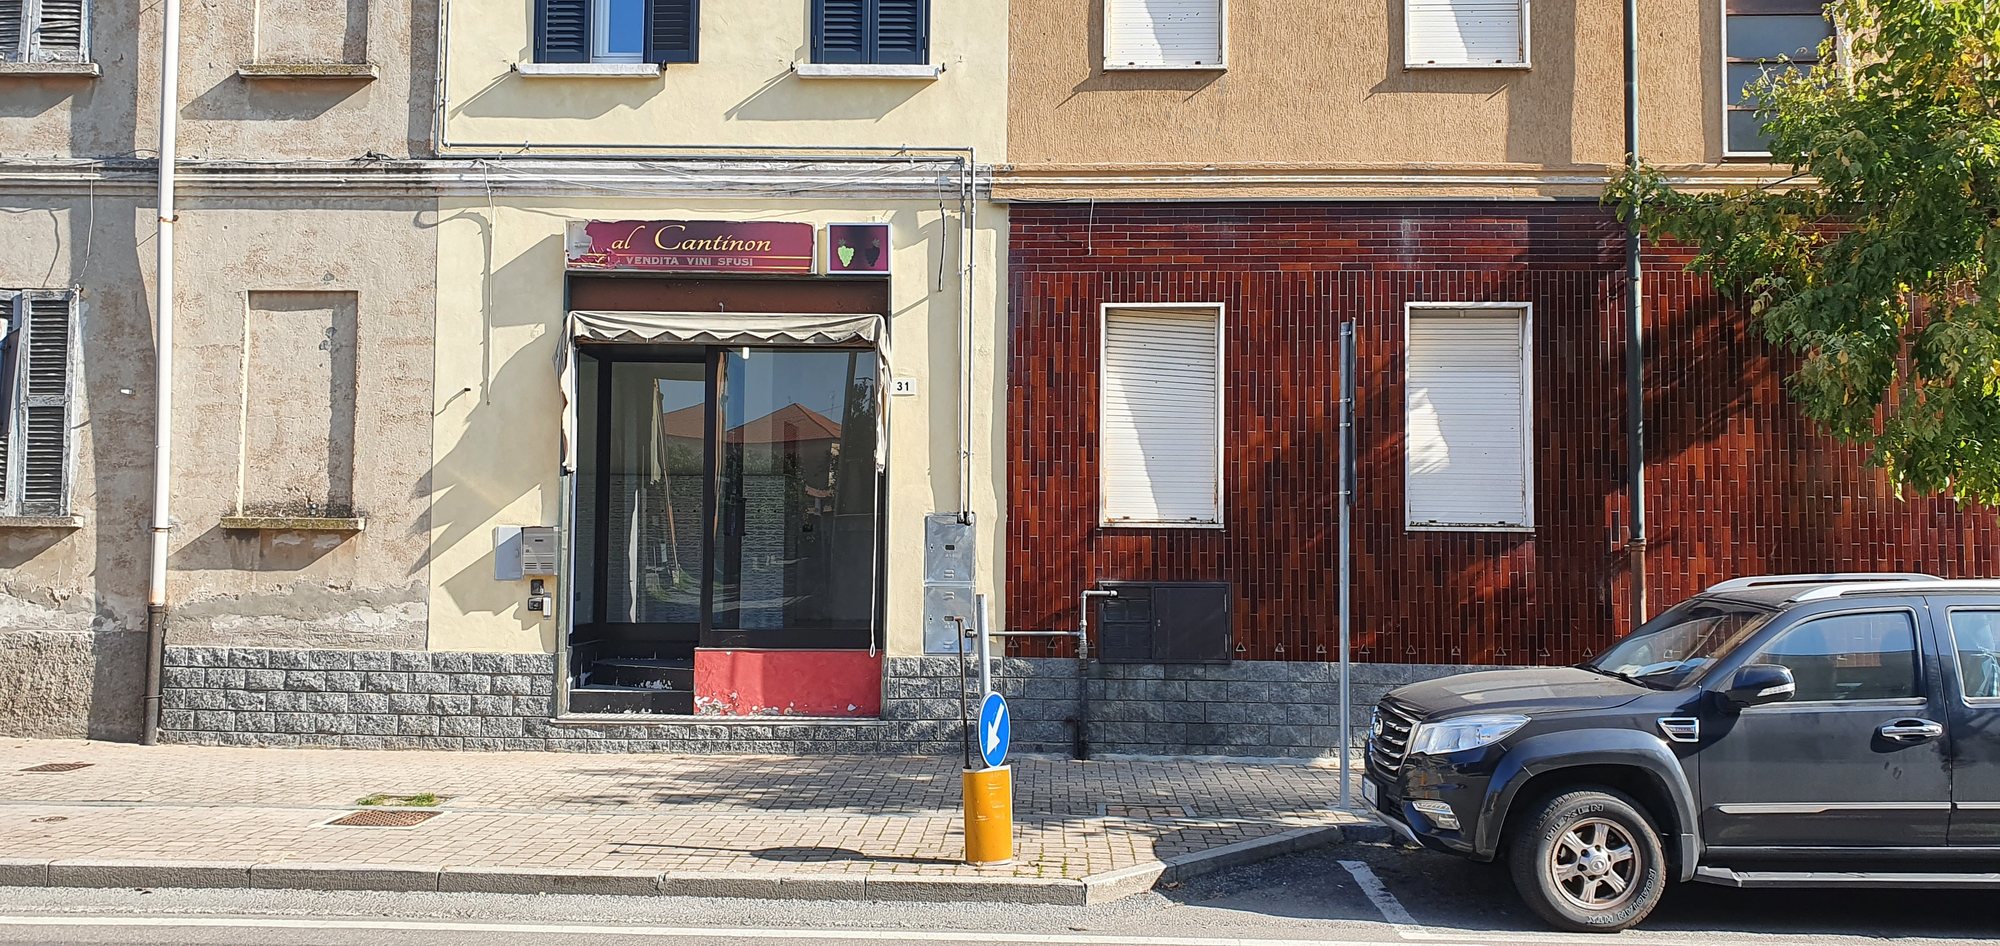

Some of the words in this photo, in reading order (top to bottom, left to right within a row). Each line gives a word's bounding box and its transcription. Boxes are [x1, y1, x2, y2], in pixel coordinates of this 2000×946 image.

[611, 225, 646, 250] al
[654, 224, 772, 251] Cantinon
[626, 256, 680, 266] VENDITA
[687, 257, 711, 266] VINI
[717, 257, 753, 267] SFUSI
[896, 381, 909, 392] 31
[1545, 803, 1604, 841] NEXEN
[1617, 868, 1657, 921] ROADIAN
